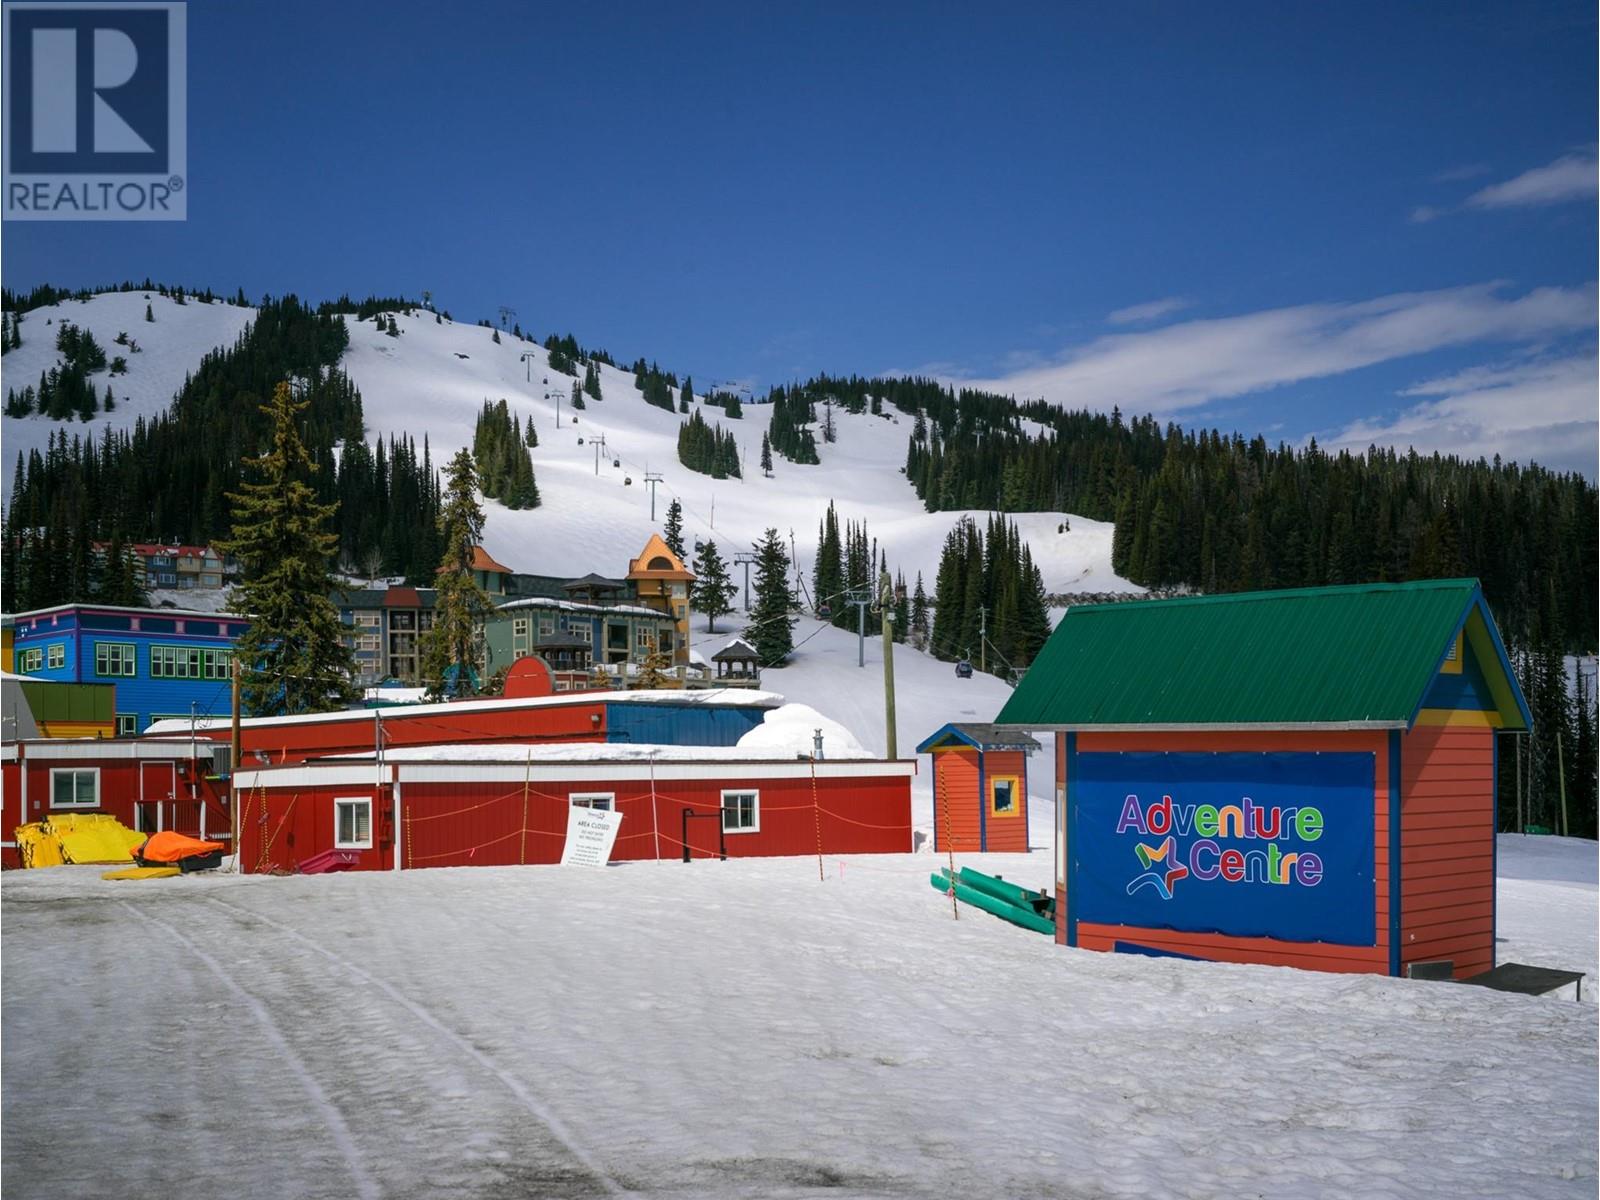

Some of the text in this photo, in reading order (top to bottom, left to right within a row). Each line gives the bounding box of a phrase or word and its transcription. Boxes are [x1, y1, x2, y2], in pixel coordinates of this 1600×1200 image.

[591, 822, 610, 831] CLOSED
[1116, 794, 1324, 842] Adventure
[1189, 839, 1324, 887] Centre
